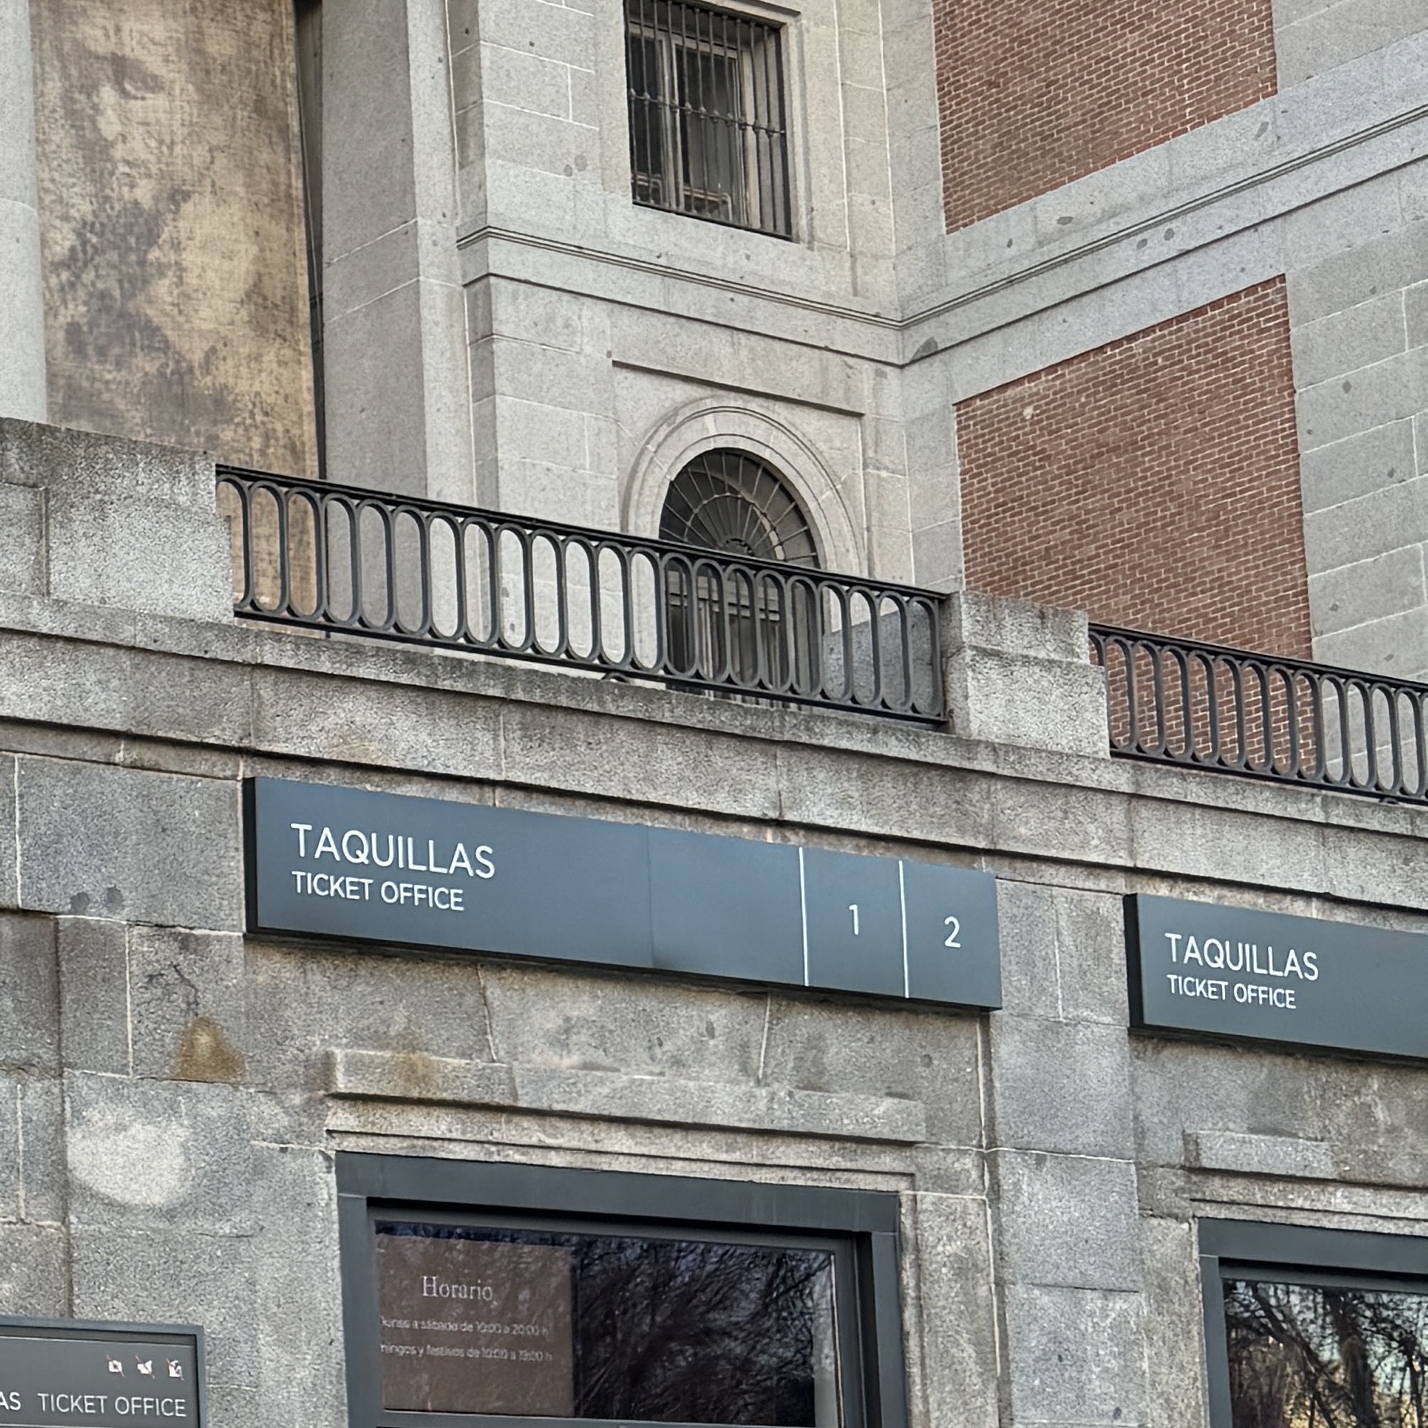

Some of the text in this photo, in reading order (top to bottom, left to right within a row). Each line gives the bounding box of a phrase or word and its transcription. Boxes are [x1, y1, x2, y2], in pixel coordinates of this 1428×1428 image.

[290, 823, 961, 948] TAQUILLAS 1 2
[291, 870, 465, 912] TICKET OFFICE
[1164, 932, 1319, 981] TAQUILLAS
[1166, 974, 1297, 1009] TICKET OFFICE
[422, 1275, 493, 1301] Horario
[37, 1392, 108, 1415] TICKET
[114, 1396, 187, 1418] OFFICE
